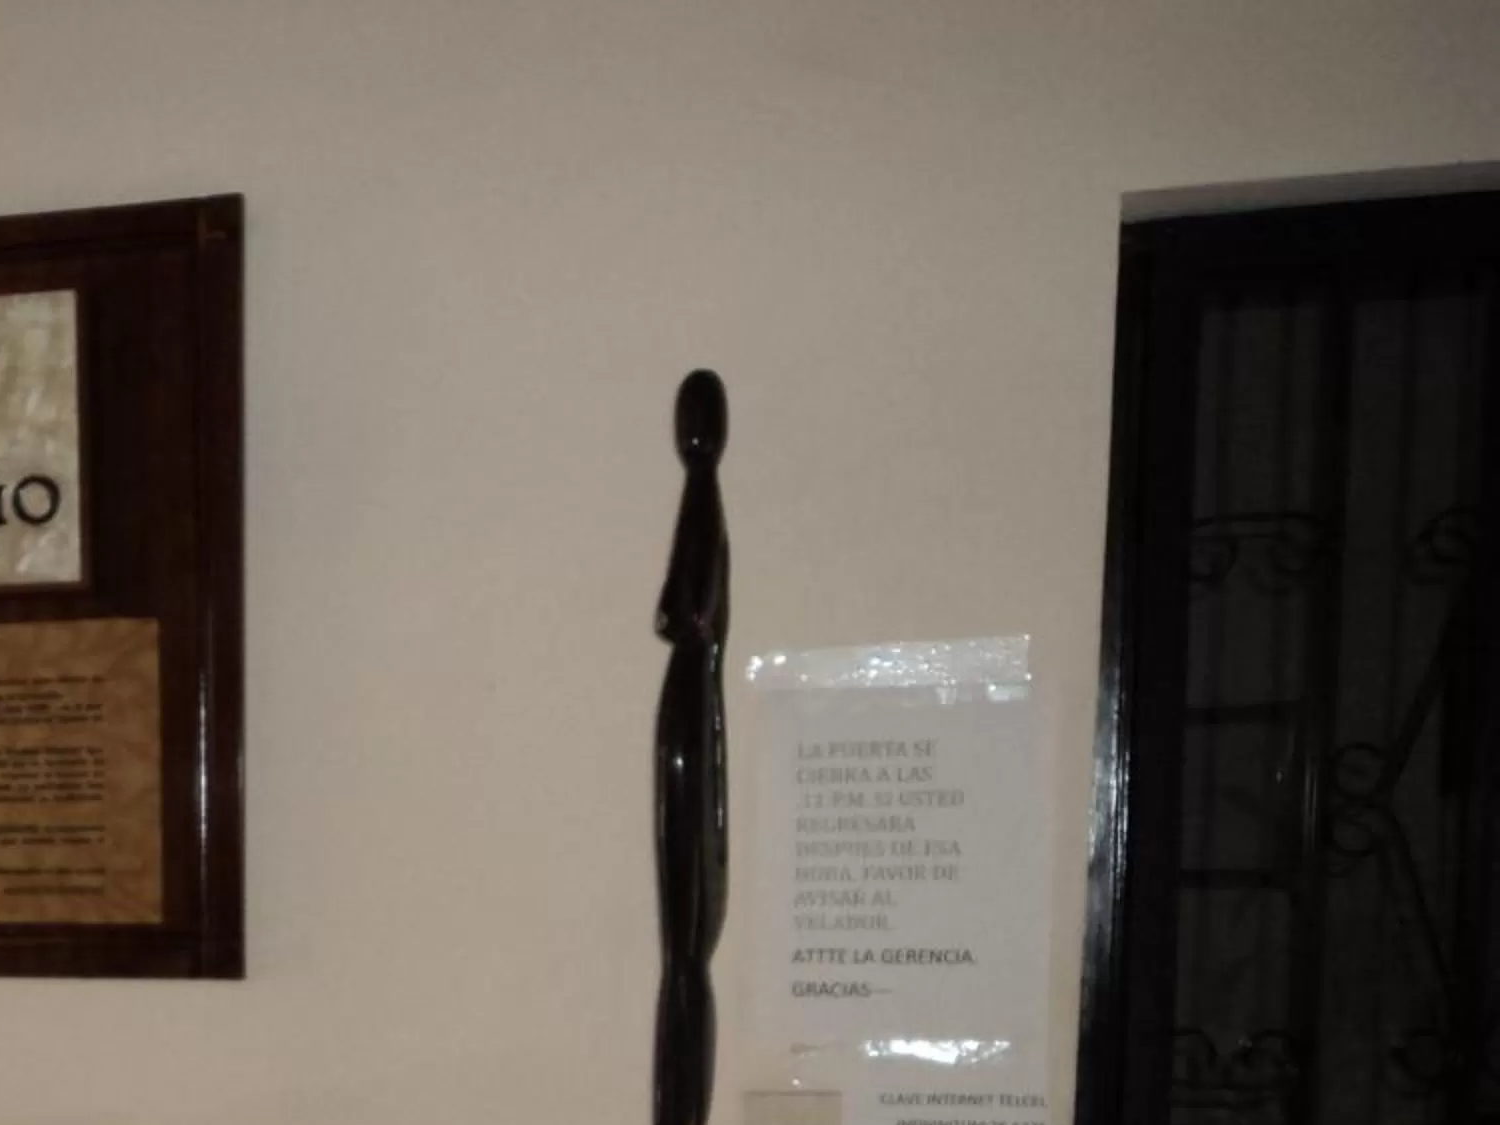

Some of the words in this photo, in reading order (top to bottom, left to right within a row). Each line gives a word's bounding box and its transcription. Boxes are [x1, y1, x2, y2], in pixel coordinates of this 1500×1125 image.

[797, 740, 823, 760] LA
[828, 741, 908, 760] PUERTA
[796, 766, 872, 784] CIERRA
[876, 767, 891, 783] A
[897, 766, 933, 783] LAS
[898, 788, 965, 807] USTED
[891, 839, 917, 857] DE
[924, 839, 962, 857] ESA
[863, 863, 927, 882] FAVOR
[933, 863, 959, 882] DE
[793, 888, 866, 908] AVISAR
[853, 947, 876, 965] LA
[927, 1092, 994, 1107] INTERNET
